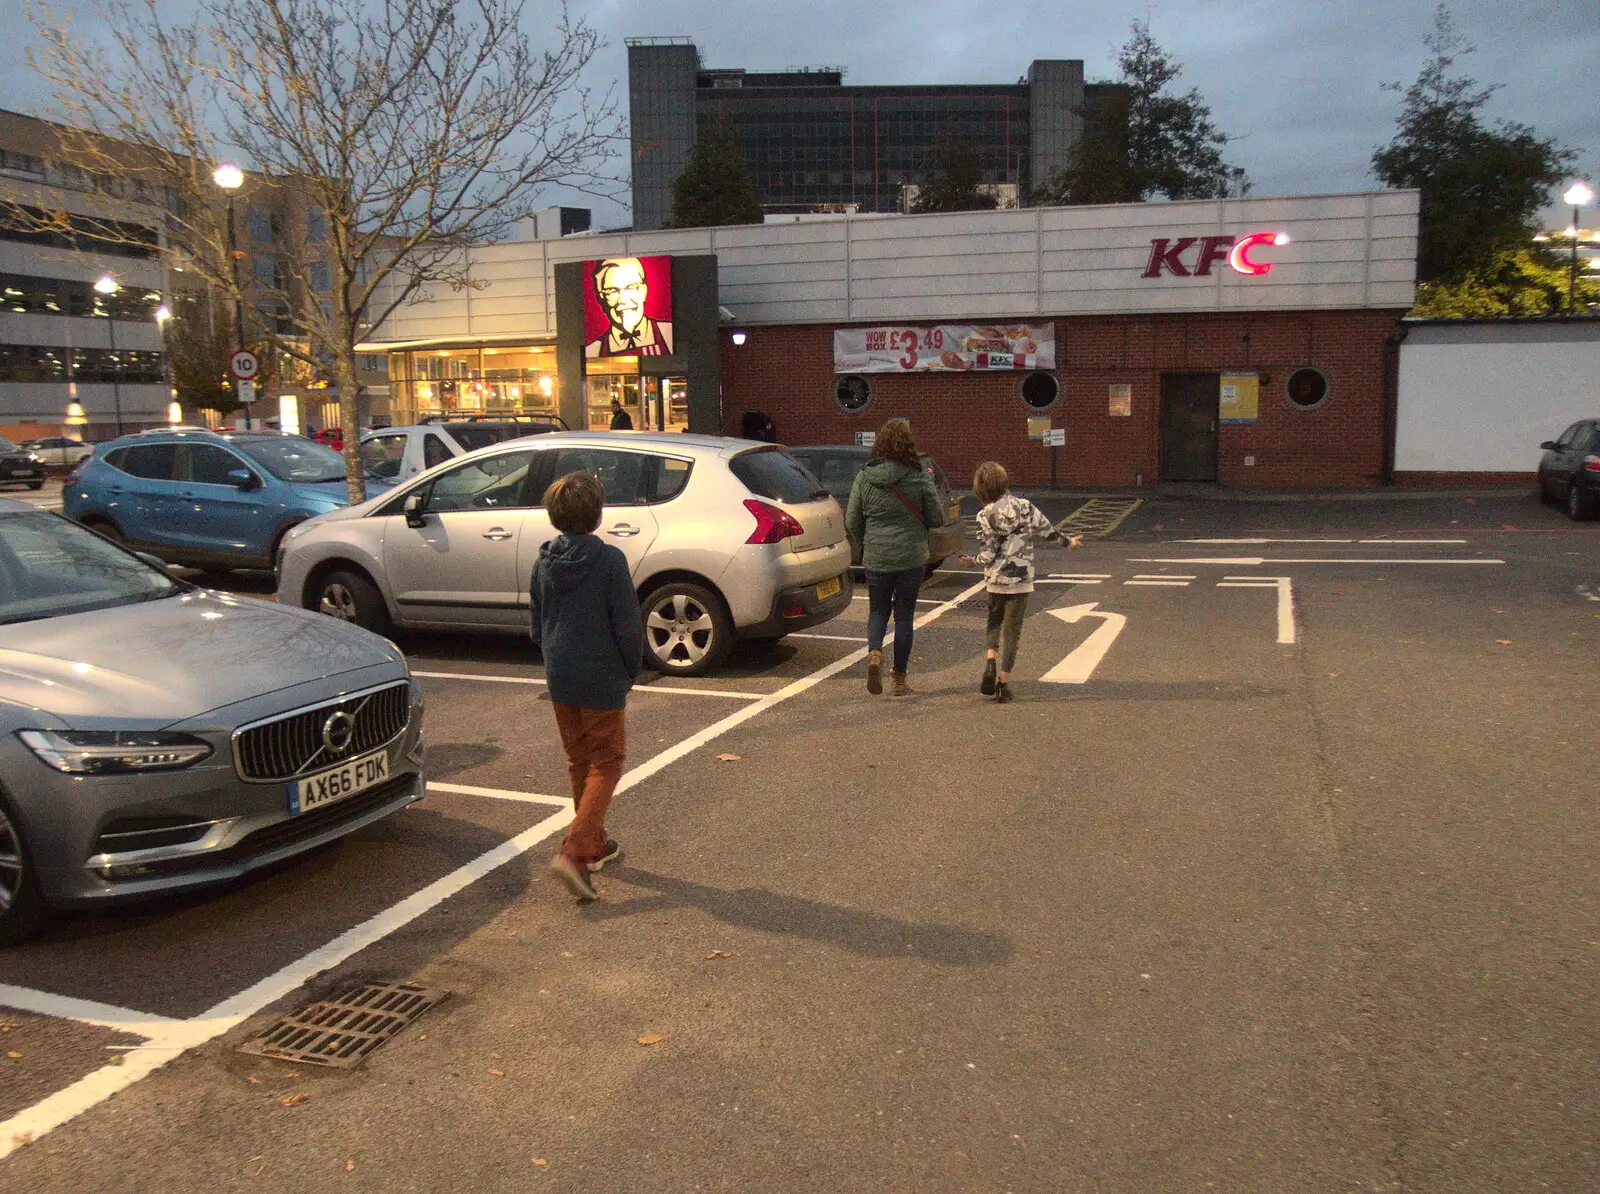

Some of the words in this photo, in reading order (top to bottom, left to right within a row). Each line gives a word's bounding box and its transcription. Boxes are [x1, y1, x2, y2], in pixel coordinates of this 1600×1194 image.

[1141, 232, 1285, 278] KFC
[866, 331, 887, 342] WOW
[865, 343, 886, 351] BOX
[236, 358, 253, 371] 10
[305, 773, 352, 807] AX66
[355, 754, 386, 788] FDK
